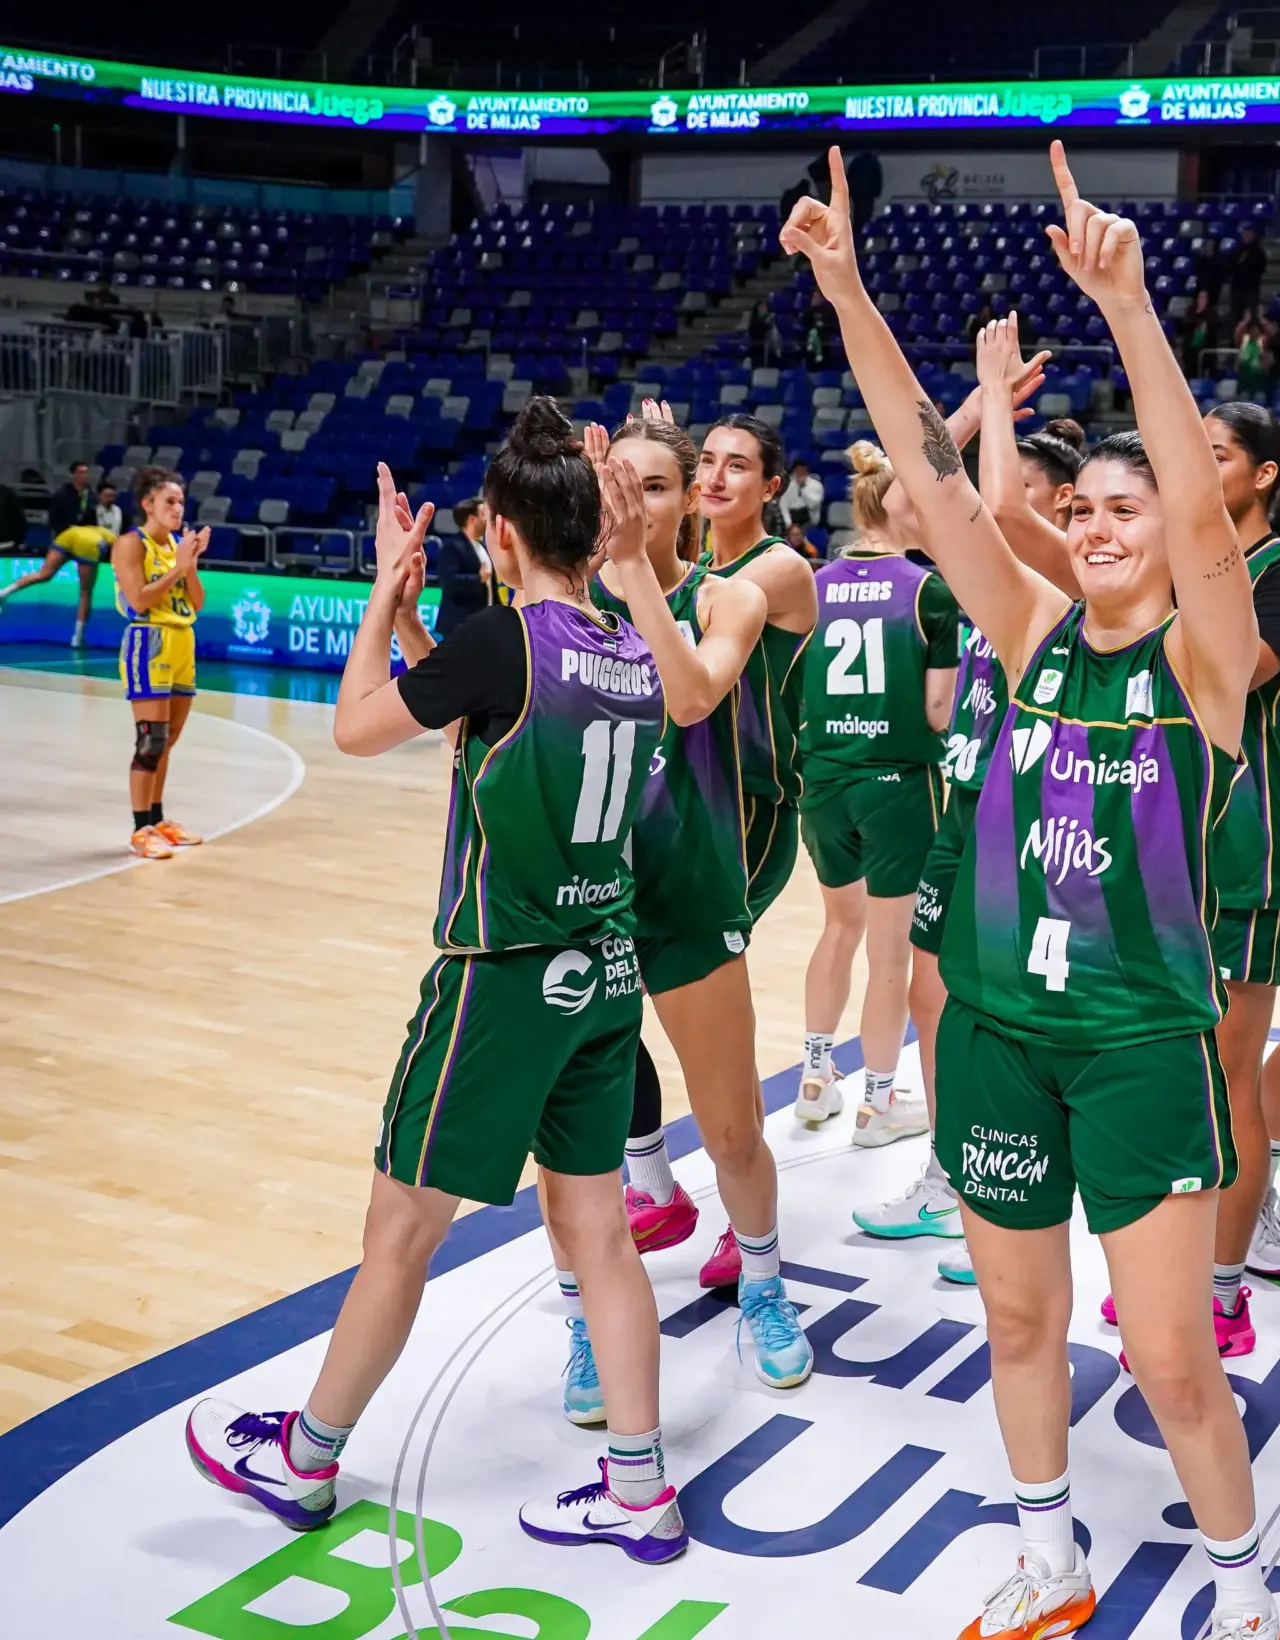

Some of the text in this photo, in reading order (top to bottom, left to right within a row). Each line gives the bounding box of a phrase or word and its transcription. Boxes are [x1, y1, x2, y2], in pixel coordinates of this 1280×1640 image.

[0, 51, 95, 82] AMIENTO
[141, 76, 383, 124] NUESTRA PROVINCIA Juega
[467, 97, 589, 113] AYUNTAMIENTO
[687, 92, 809, 110] AYUNTAMIENTO
[845, 89, 1072, 122] NUESTRA PROVINCIA Juega
[1161, 101, 1246, 119] DE MIJAS
[467, 112, 541, 130] DE MIJAS
[686, 110, 760, 128] DE MIJAS
[826, 581, 893, 603] ROTERS
[289, 625, 319, 653] DE
[824, 618, 885, 695] 21
[939, 734, 982, 781] 20
[1051, 747, 1159, 793] Unicaja
[570, 720, 636, 843] 11
[1020, 816, 1112, 885] Mijas
[1027, 916, 1071, 992] 4
[605, 961, 633, 982] DEL
[971, 1125, 1038, 1147] CLINICAS
[963, 1180, 1029, 1203] DENTAL
